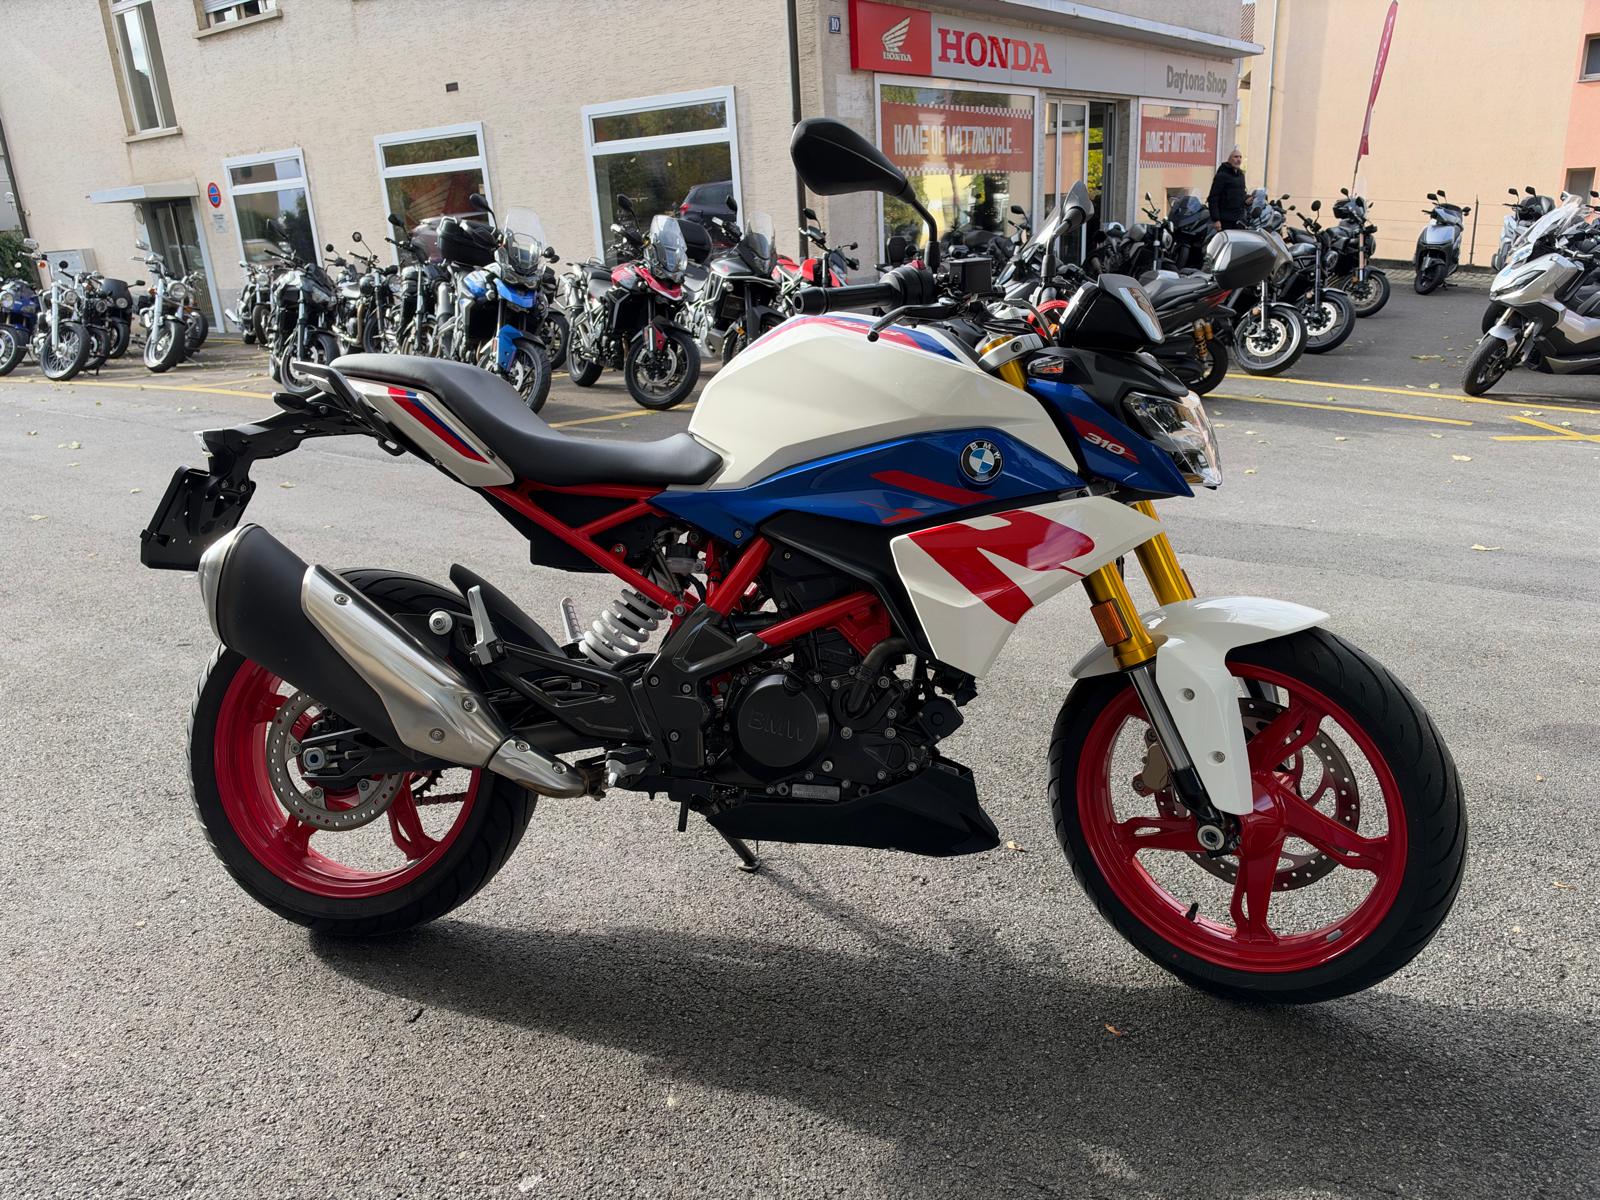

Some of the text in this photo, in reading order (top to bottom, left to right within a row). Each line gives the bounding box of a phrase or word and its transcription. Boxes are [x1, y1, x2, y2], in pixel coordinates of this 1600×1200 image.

[883, 51, 913, 62] HONDA
[937, 28, 1052, 74] HONDA
[1166, 64, 1227, 98] Daytona Shop
[931, 125, 945, 155] OF
[1084, 432, 1126, 455] 310
